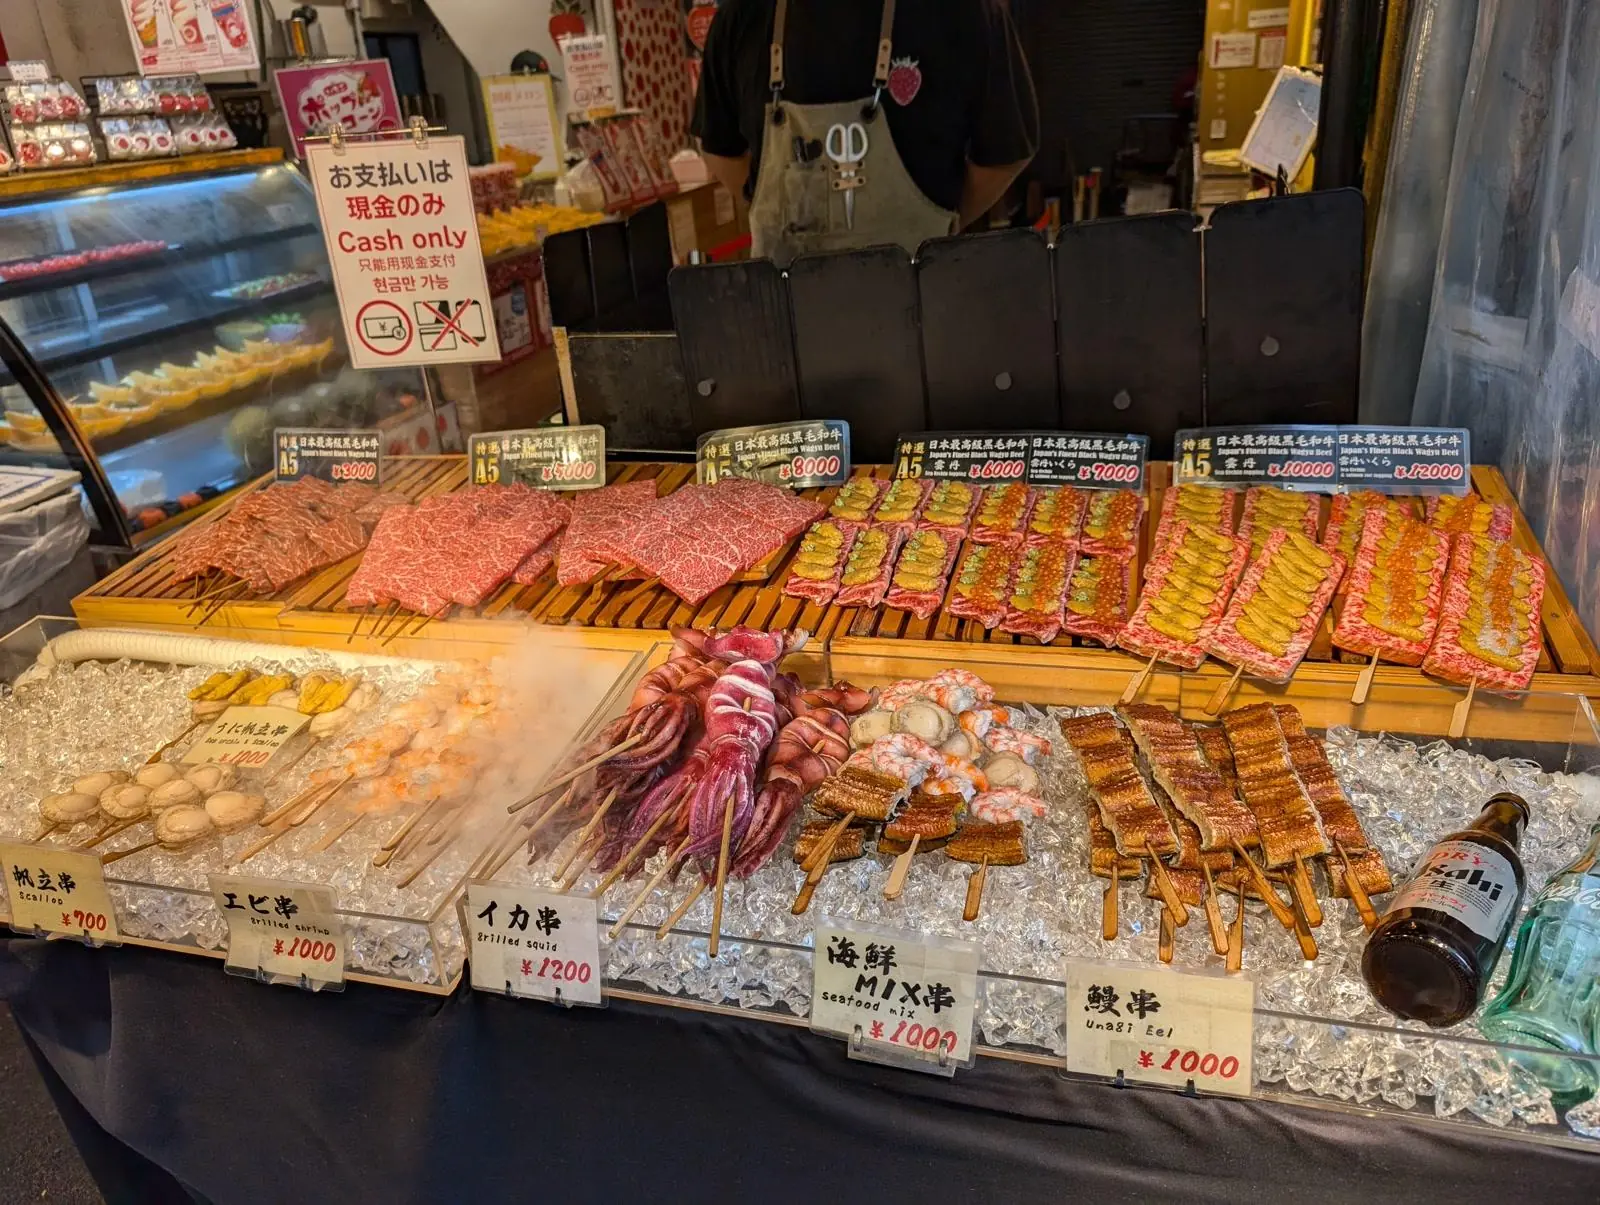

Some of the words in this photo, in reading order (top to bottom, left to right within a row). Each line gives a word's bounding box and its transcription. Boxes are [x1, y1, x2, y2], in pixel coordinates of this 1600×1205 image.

[328, 159, 453, 189] お支払いは
[345, 192, 446, 221] 現金のみ
[338, 228, 404, 253] Cash
[412, 225, 468, 250] only
[358, 254, 456, 273] 只能用现金支付
[372, 276, 417, 294] 현금만
[420, 274, 449, 291] 가능
[476, 440, 501, 456] 特選
[705, 443, 732, 459] 特選
[734, 428, 843, 452] 日本最高級黒毛和牛
[824, 443, 840, 451] Beef
[901, 441, 925, 455] 特選
[929, 438, 1029, 451] 日本最高級黒毛和牛
[1032, 437, 1141, 453] 日本最高級黒毛和牛
[1183, 438, 1212, 451] 特選
[1216, 434, 1336, 448] 日本最高級黒毛和牛
[1338, 433, 1462, 448] 日本最高級黒毛和牛
[279, 451, 299, 475] A5
[1340, 447, 1368, 455] Japan's
[1369, 447, 1391, 455] Finest
[1392, 447, 1414, 455] Black
[1415, 448, 1440, 457] Wagyu
[1441, 448, 1459, 456] Beef
[475, 458, 500, 484] A5
[778, 455, 841, 480] ¥8000
[896, 456, 923, 479] A5
[968, 460, 1025, 479] ¥6000
[1180, 452, 1212, 478] A5
[1267, 461, 1335, 477] ¥10000
[1393, 463, 1464, 480] ¥12000
[215, 721, 289, 737] うに帆立串
[12, 864, 77, 894] 帆立串
[223, 892, 299, 920] エビ串
[61, 909, 107, 931] ¥700
[477, 900, 562, 937] イカ串
[273, 936, 337, 963] ¥1000
[477, 931, 520, 947] grilled
[526, 939, 558, 952] squid
[826, 935, 898, 976] 海鮮
[520, 956, 592, 984] ¥1200
[854, 973, 956, 1014] MIX串
[1084, 983, 1162, 1020] 鰻串
[822, 991, 881, 1013] seafood
[889, 1006, 916, 1020] mix
[869, 1019, 958, 1055] ¥1000
[1085, 1019, 1134, 1034] Unagi
[1145, 1024, 1174, 1039] Eel
[1137, 1048, 1240, 1079] ¥1000
